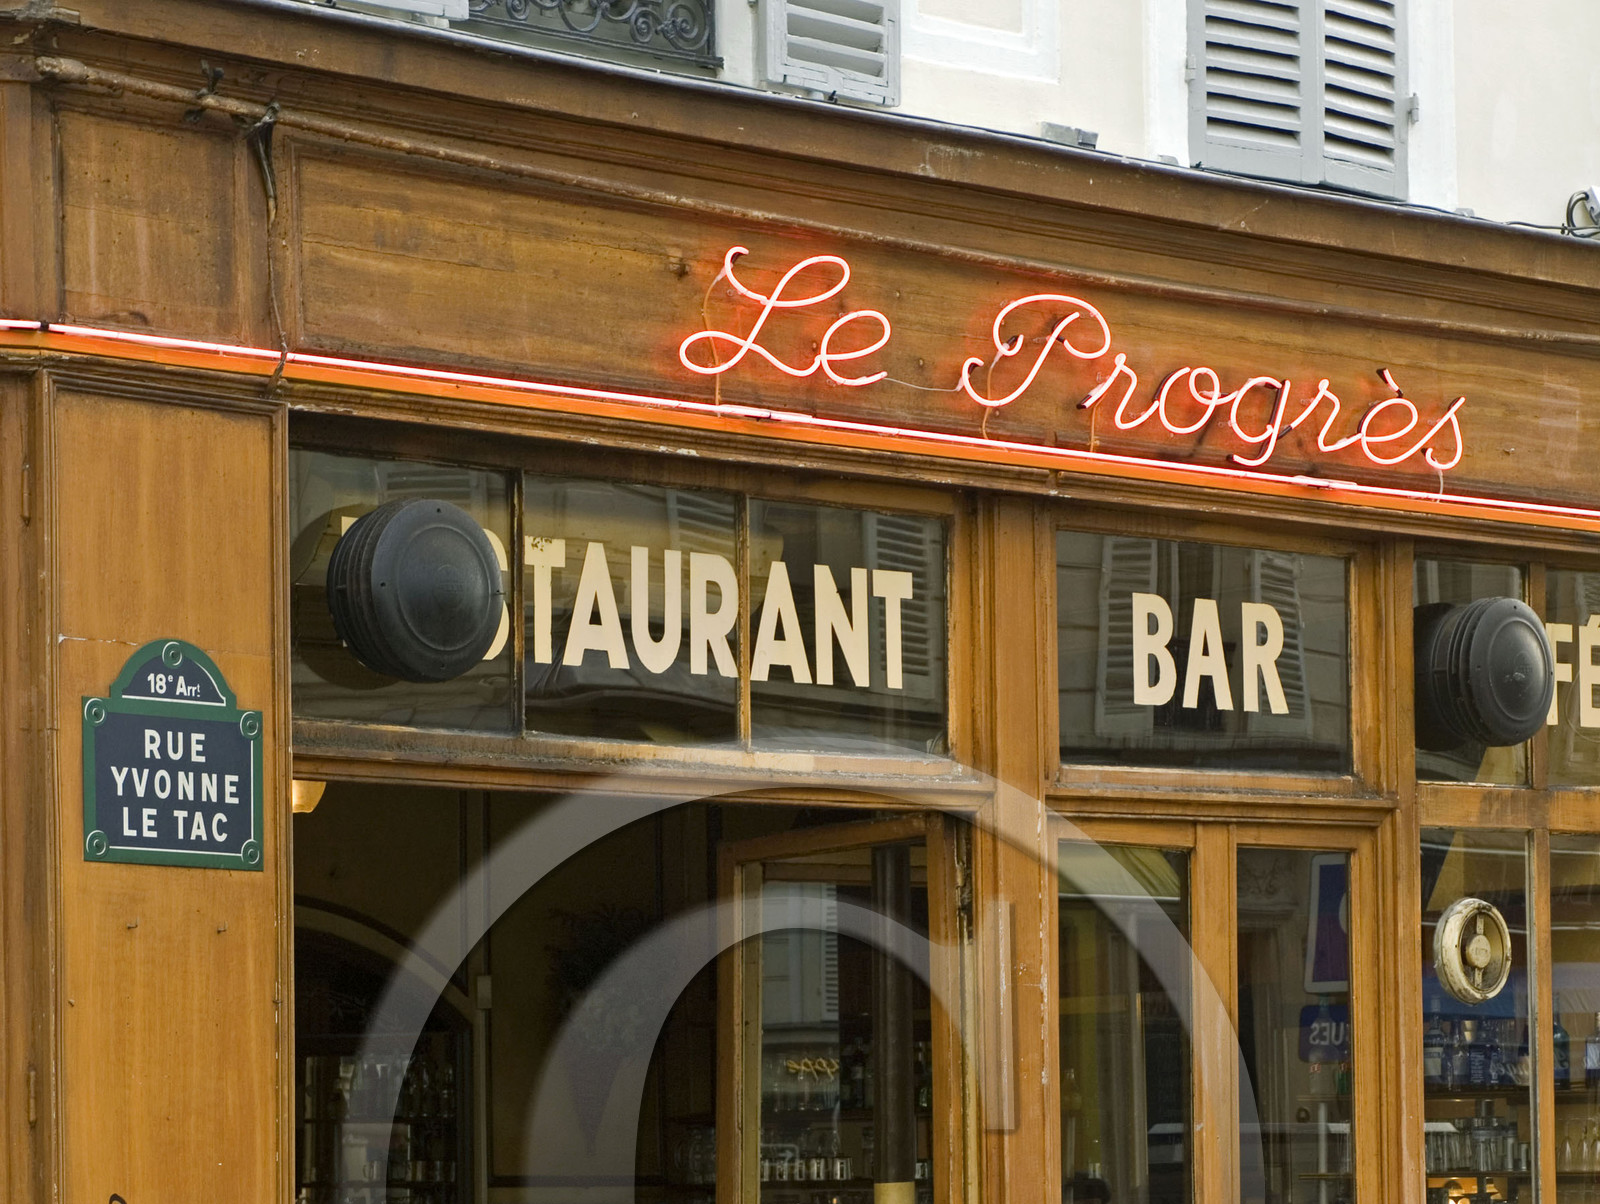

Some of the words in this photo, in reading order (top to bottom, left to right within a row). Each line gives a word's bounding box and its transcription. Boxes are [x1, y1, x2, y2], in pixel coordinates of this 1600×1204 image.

[679, 246, 891, 386] Le
[961, 293, 1466, 470] Progrès
[341, 516, 913, 690] TAURANT
[1132, 592, 1290, 715] BAR
[1545, 614, 1600, 728] FÉ
[110, 765, 240, 805] YVONNE
[144, 728, 206, 763] RUE
[122, 806, 158, 838] LE
[173, 809, 229, 843] TAC
